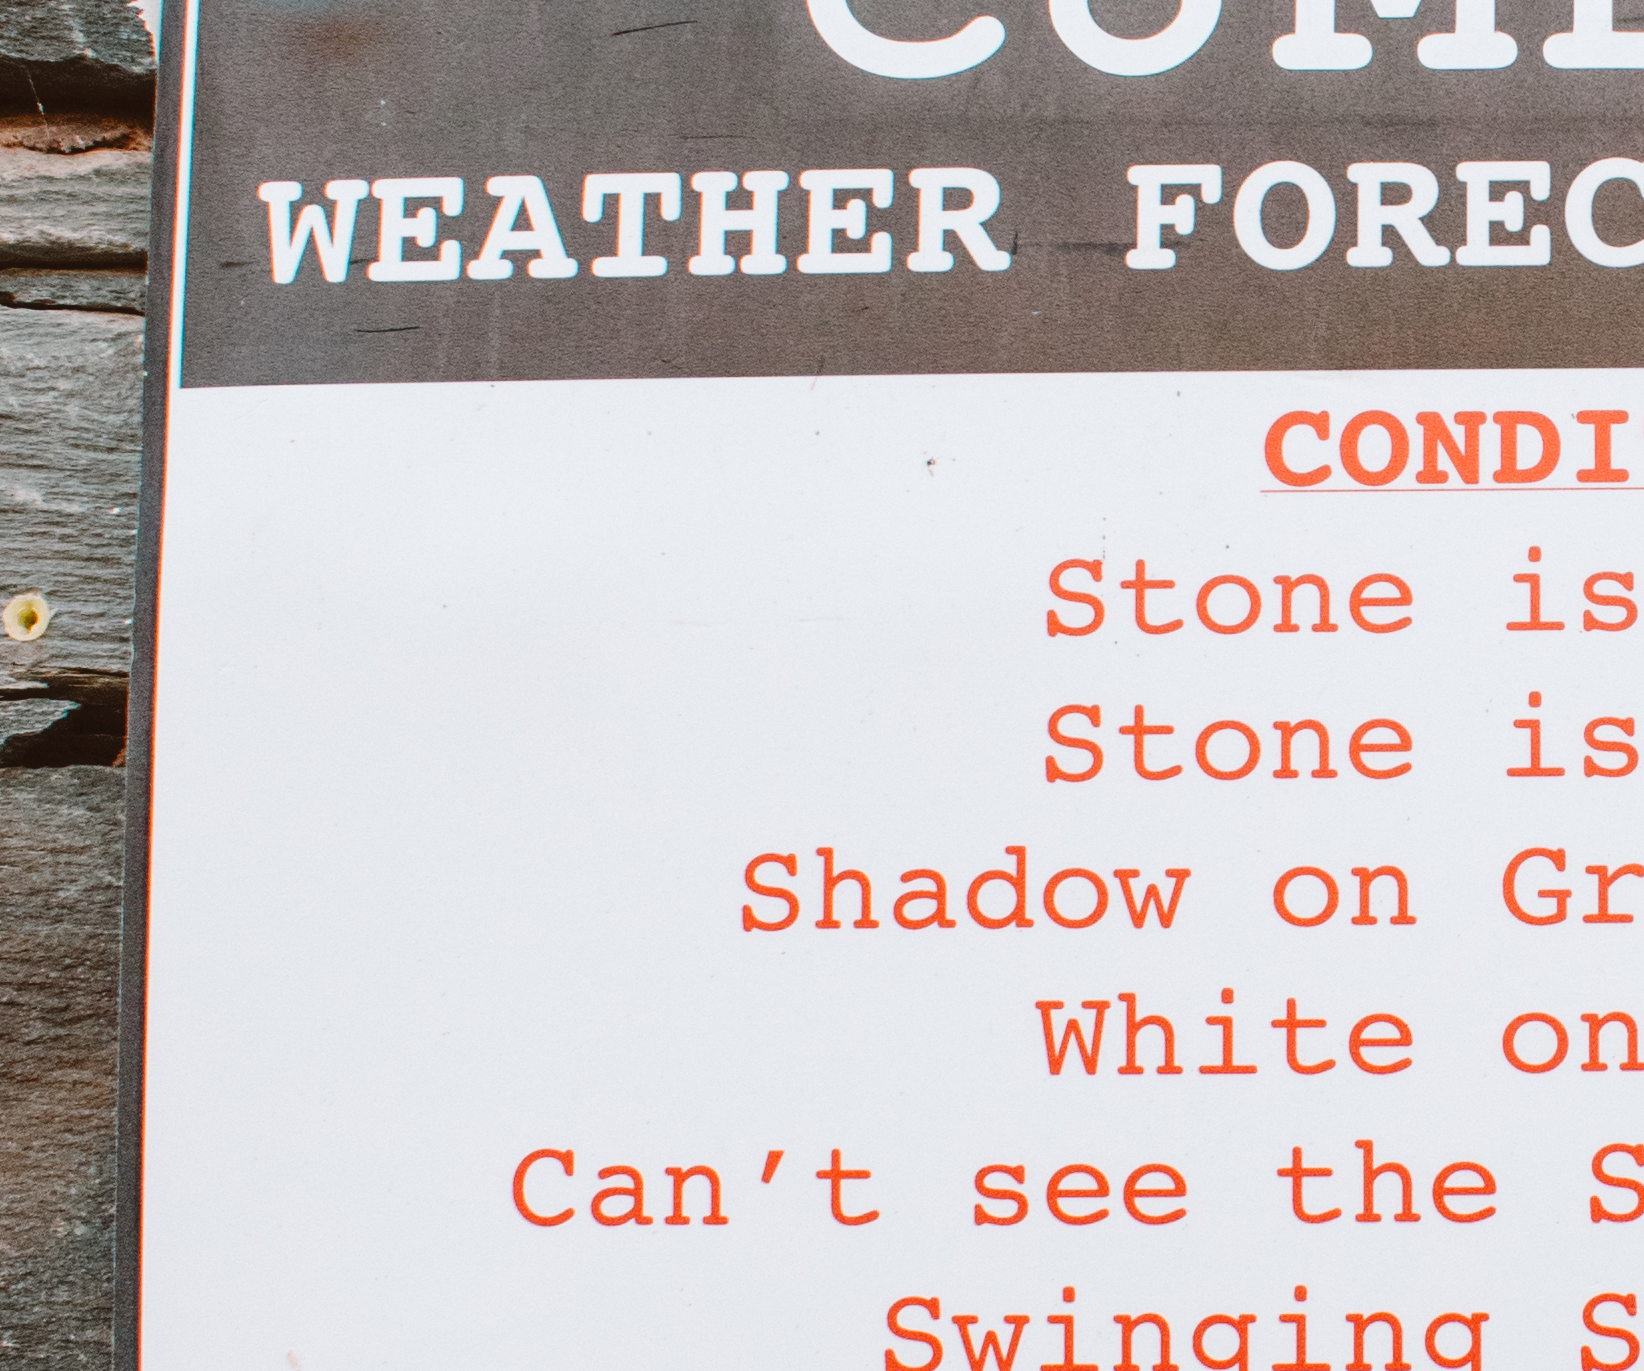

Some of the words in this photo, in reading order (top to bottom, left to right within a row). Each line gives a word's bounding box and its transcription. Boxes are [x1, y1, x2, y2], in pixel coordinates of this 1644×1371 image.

[258, 166, 1011, 285] WEATHER
[1046, 558, 1414, 638] Stone
[1506, 545, 1638, 632] is
[1045, 703, 1413, 783] Stone
[1506, 690, 1639, 778] is
[742, 845, 1192, 933] Shadow
[1272, 864, 1418, 928] on
[1034, 987, 1414, 1076] White
[512, 1147, 881, 1227] Can't
[974, 1162, 1188, 1226] see
[1278, 1138, 1497, 1224] the
